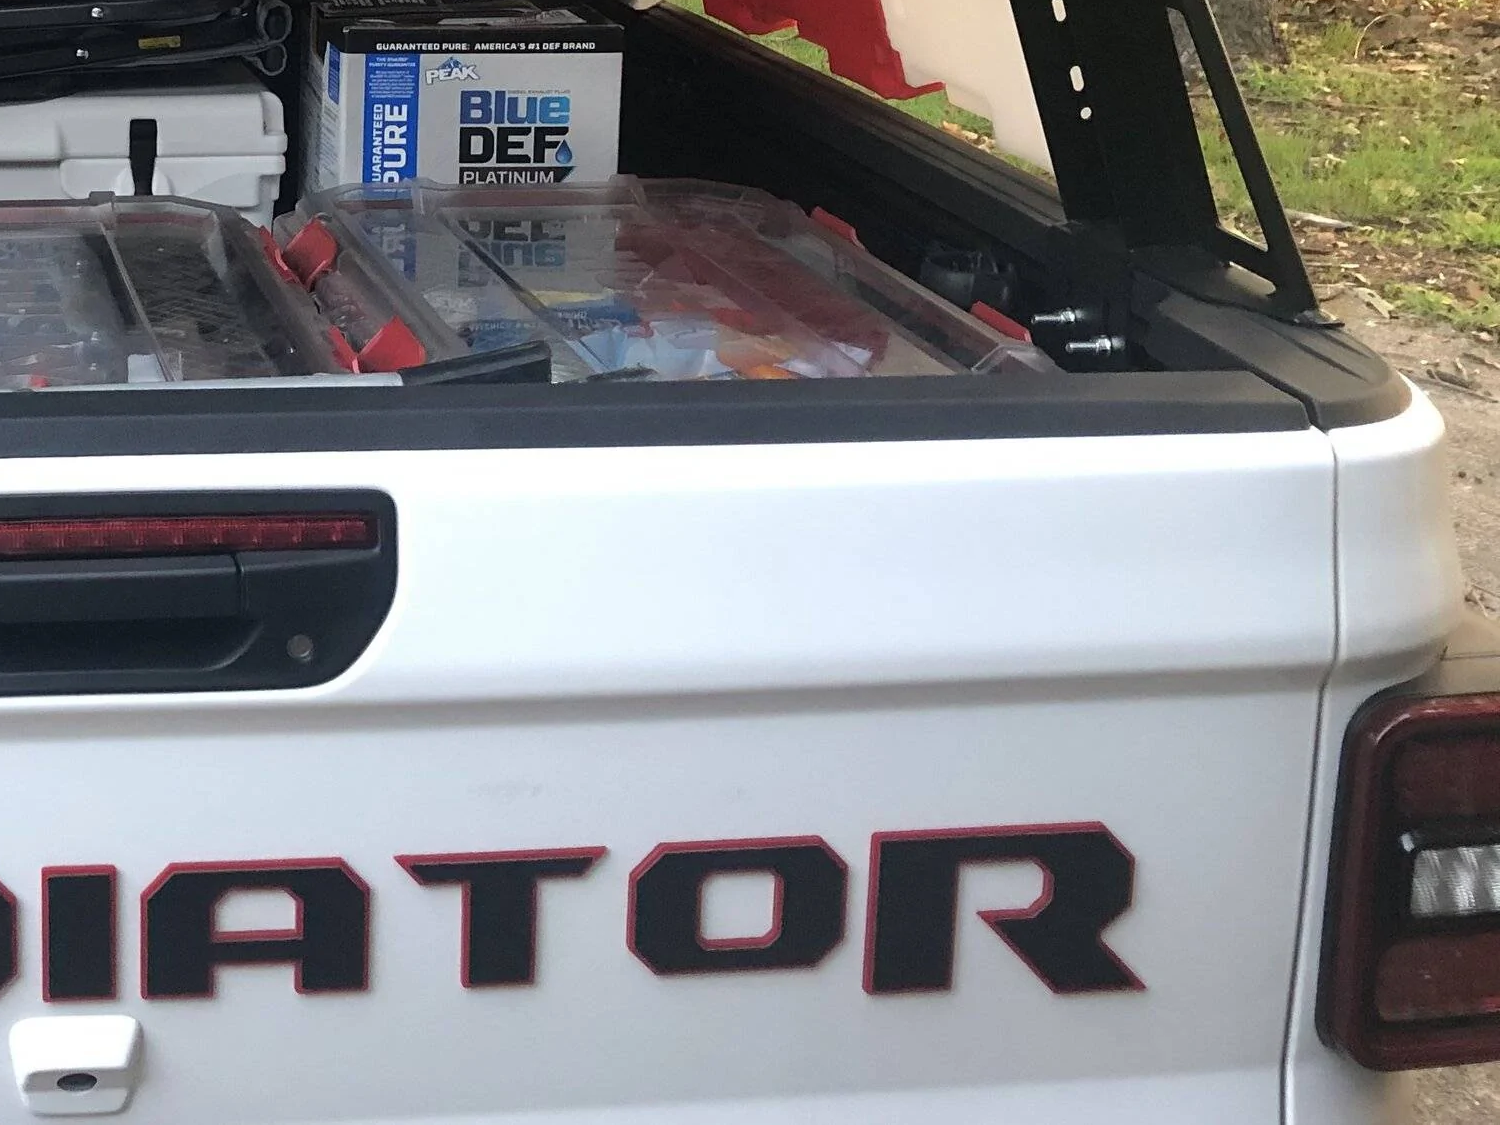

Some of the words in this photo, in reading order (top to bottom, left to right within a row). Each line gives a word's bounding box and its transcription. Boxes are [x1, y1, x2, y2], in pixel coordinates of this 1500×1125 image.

[376, 42, 440, 51] GUARANTEED
[442, 42, 471, 51] PURE:
[474, 42, 526, 51] AMERICA'S
[528, 42, 540, 51] #1
[542, 42, 561, 51] DEF
[563, 42, 596, 51] BRAND
[425, 65, 480, 85] PEAK
[460, 90, 570, 124] Blue
[372, 104, 384, 182] UARANTEED
[459, 127, 569, 163] DEF
[463, 170, 554, 185] PLATINUM
